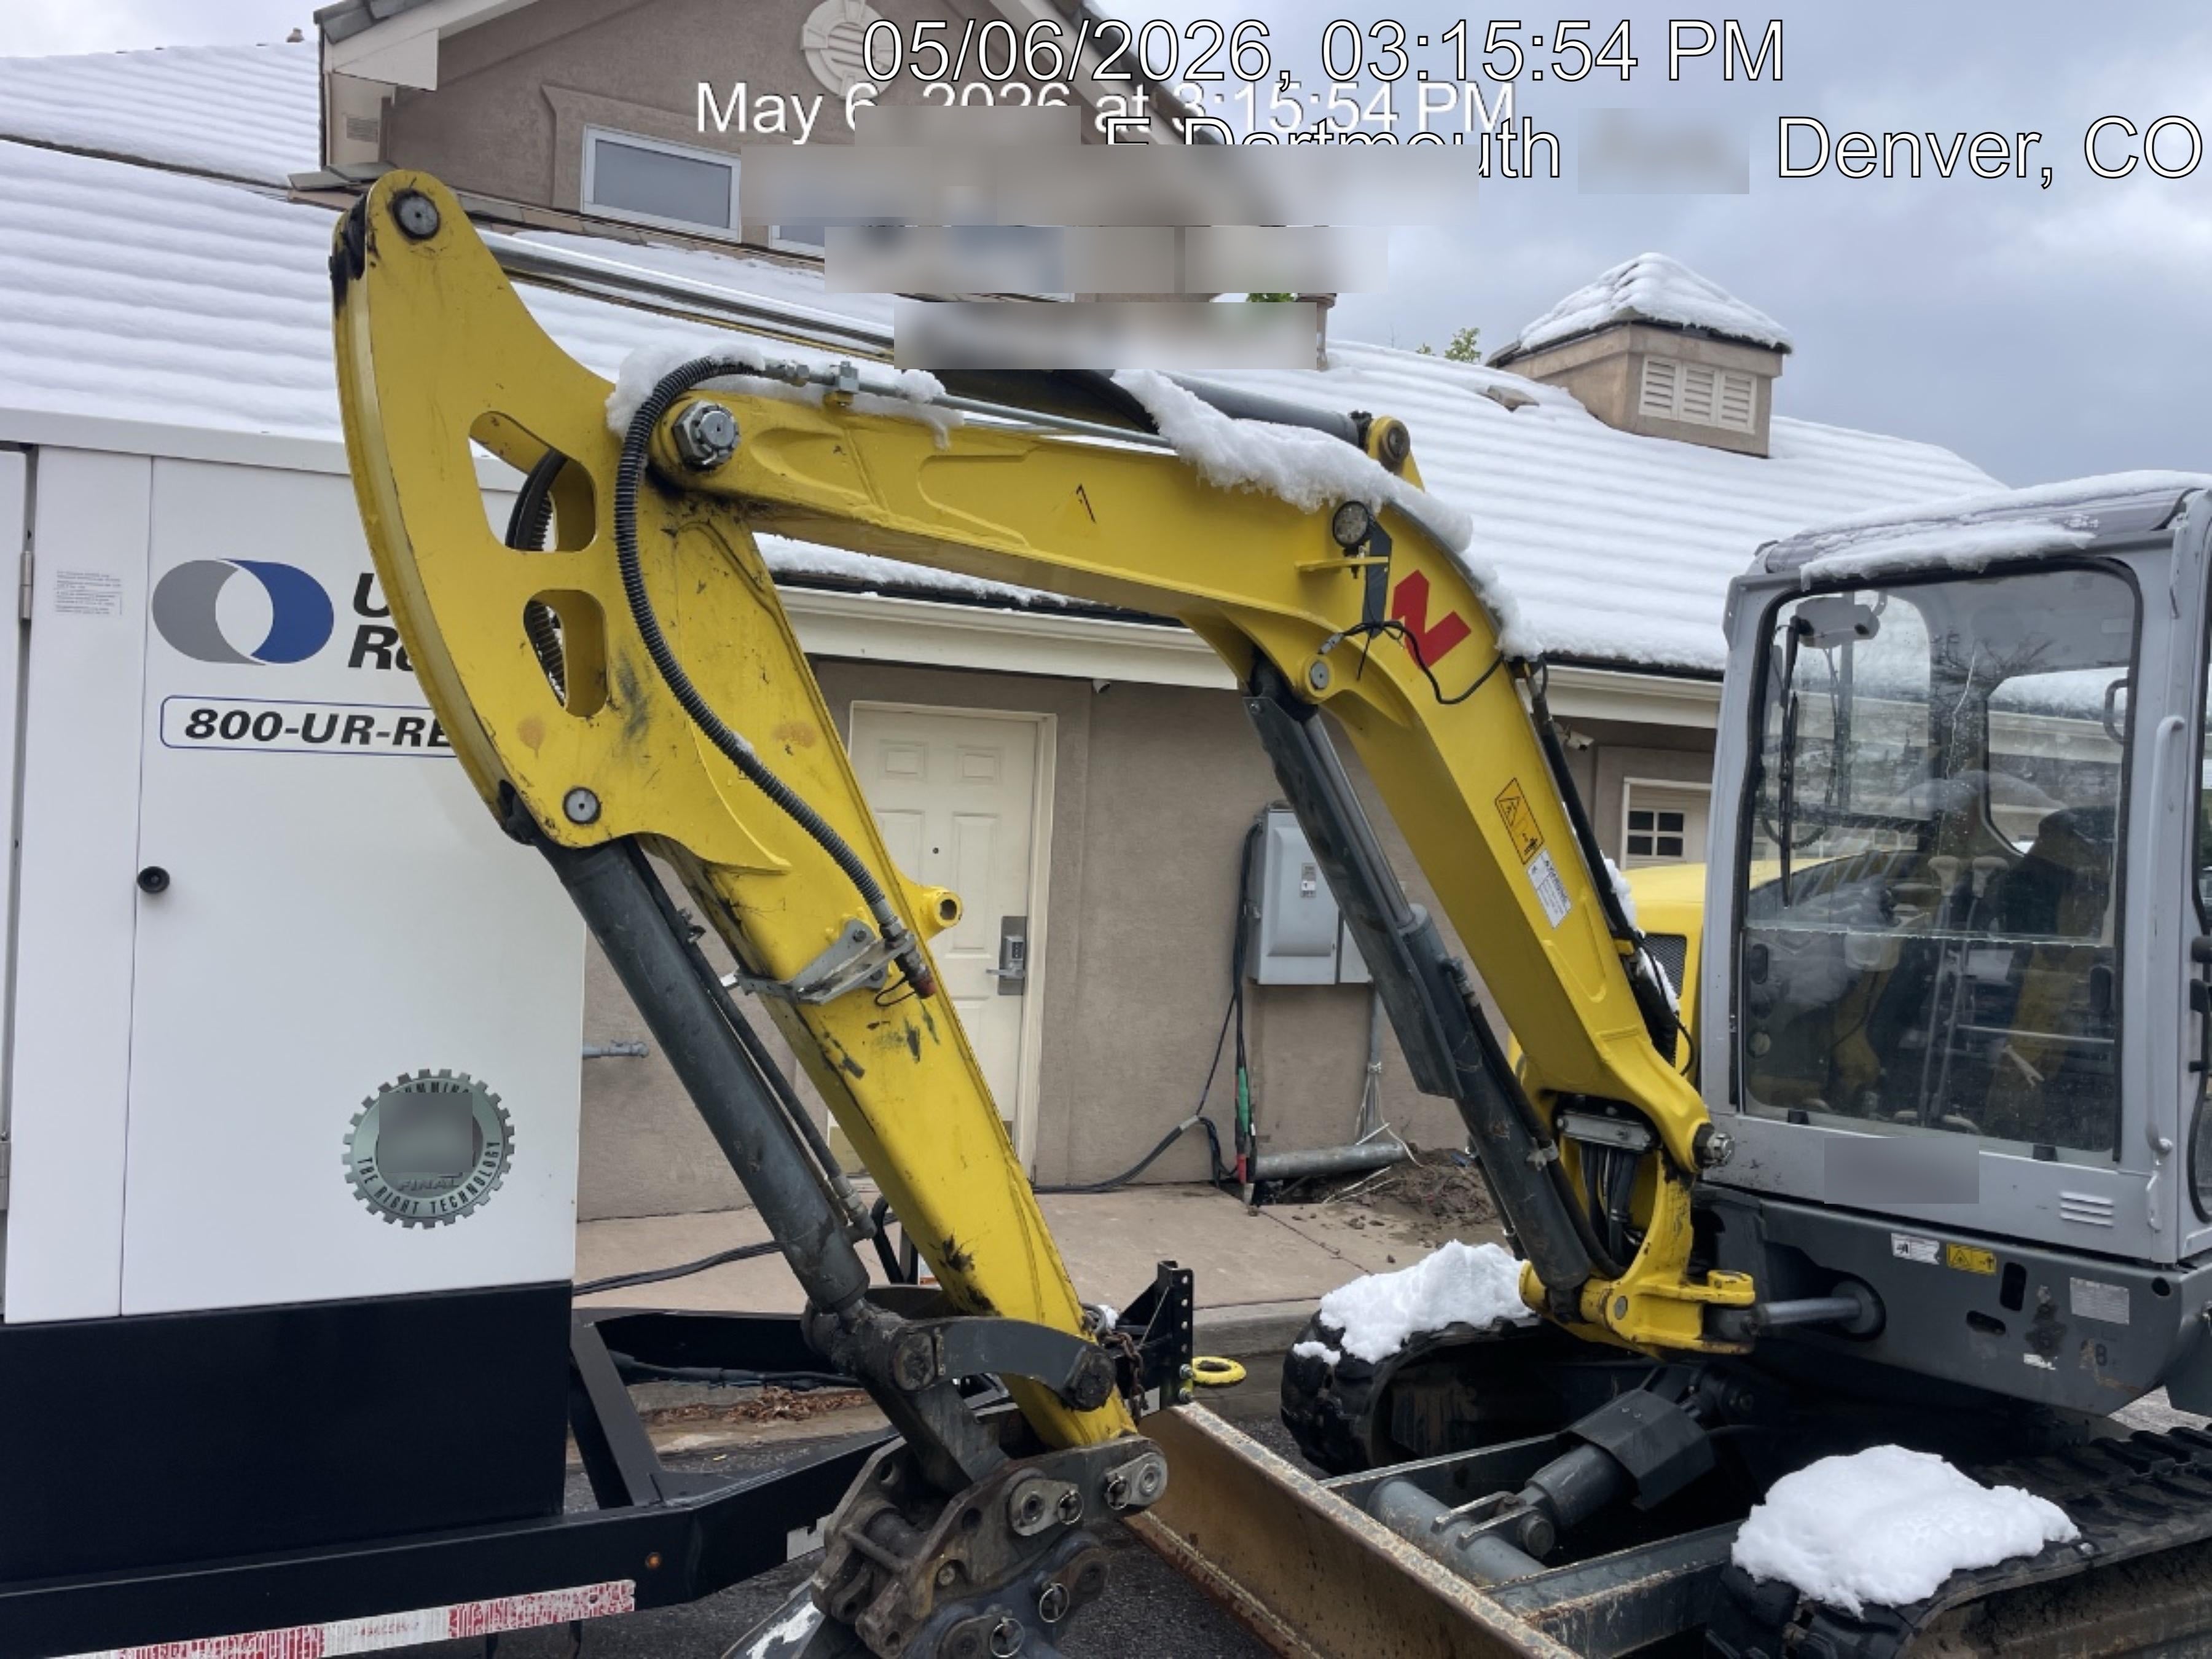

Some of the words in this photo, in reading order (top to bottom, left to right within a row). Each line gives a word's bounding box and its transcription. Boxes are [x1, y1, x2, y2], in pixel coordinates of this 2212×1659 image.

[357, 1156, 379, 1184] THE
[373, 1185, 420, 1215] RIGHT
[429, 1141, 501, 1214] TECHNOLOGY
